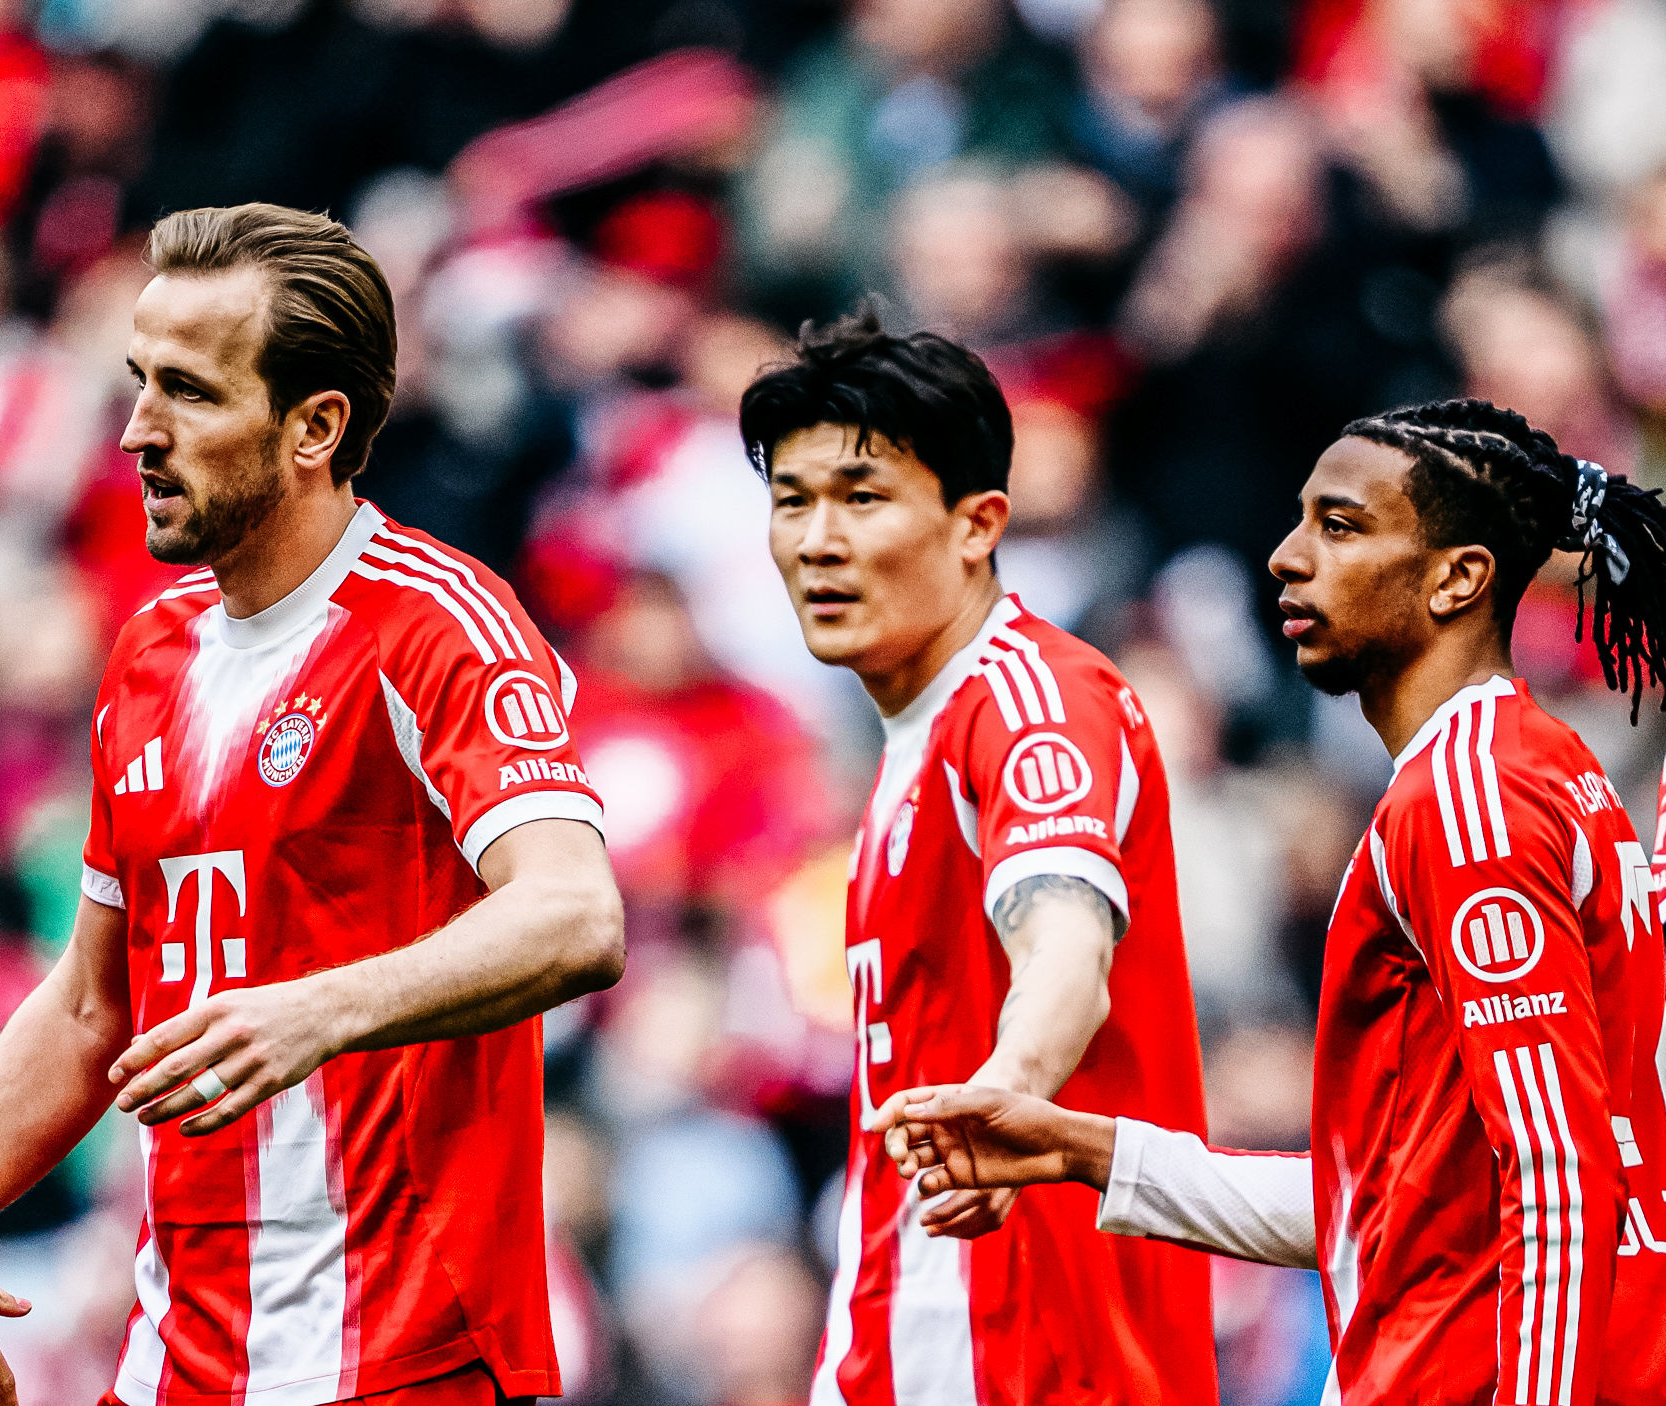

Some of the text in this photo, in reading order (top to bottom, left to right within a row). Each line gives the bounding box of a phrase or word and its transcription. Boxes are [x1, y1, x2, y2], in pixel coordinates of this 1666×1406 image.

[267, 718, 311, 746] FC BAYERN
[498, 757, 593, 791] Allian
[1006, 815, 1108, 846] Allianz
[1463, 990, 1568, 1028] Allianz
